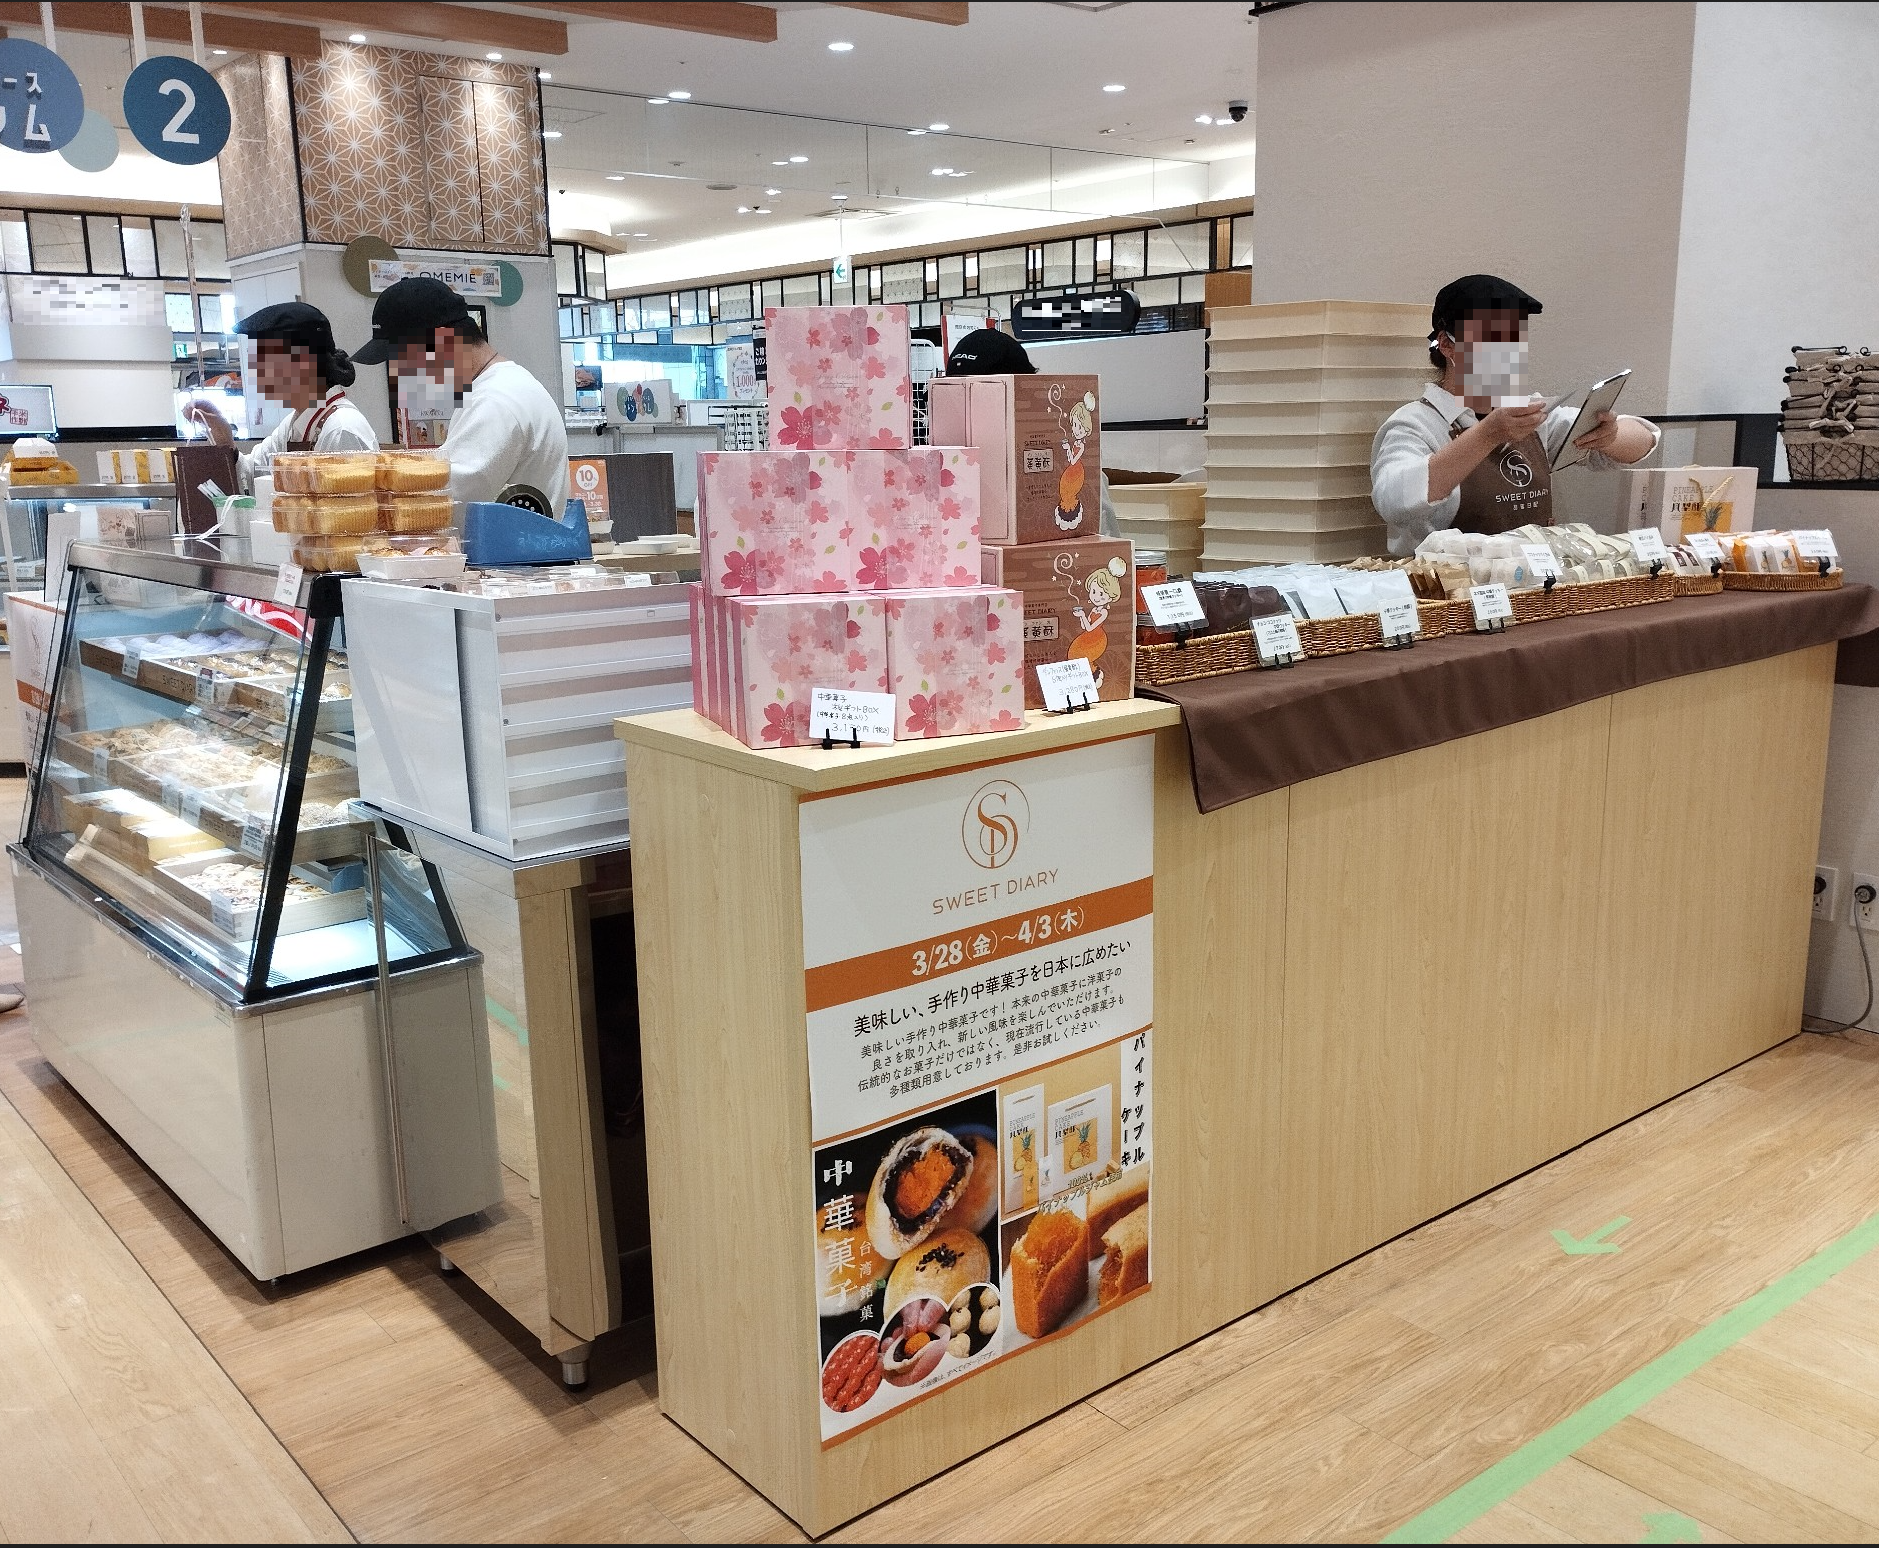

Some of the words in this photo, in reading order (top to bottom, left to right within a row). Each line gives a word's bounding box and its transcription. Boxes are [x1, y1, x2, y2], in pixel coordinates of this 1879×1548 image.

[0, 103, 51, 142] ム
[158, 79, 200, 144] 2
[1495, 492, 1527, 503] SWEET
[932, 883, 1001, 915] SWEET
[1007, 868, 1059, 895] DIARY
[854, 941, 1131, 1038] 美味しい、手作り中華菓子を日本に広めたい
[1133, 1032, 1147, 1165] パイナップル
[1120, 1106, 1132, 1167] ケーキ
[823, 1159, 858, 1308] 中華菓子
